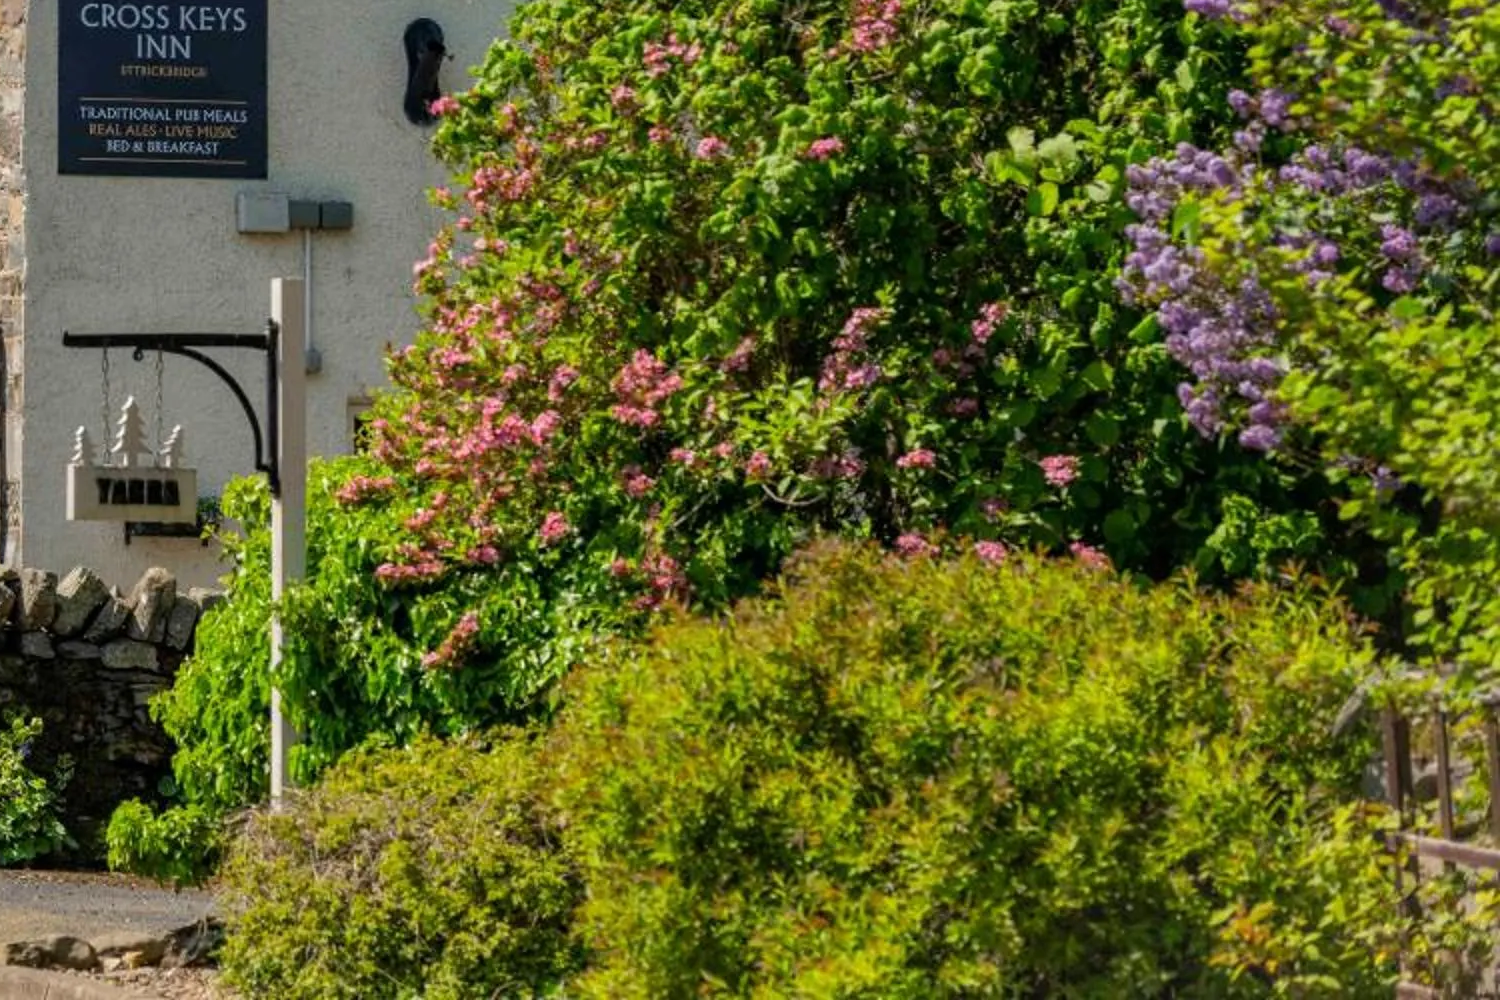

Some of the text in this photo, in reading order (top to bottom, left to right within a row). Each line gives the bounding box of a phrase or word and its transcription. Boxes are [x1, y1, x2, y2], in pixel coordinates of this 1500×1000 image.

[80, 3, 248, 31] CROSS KEYS
[137, 34, 191, 59] INN
[80, 106, 248, 124] TRADITIONAL PUB MEALS
[89, 123, 238, 139] REAL ALES LIVE MUSIC
[106, 140, 220, 155] BED & BREAKFAST
